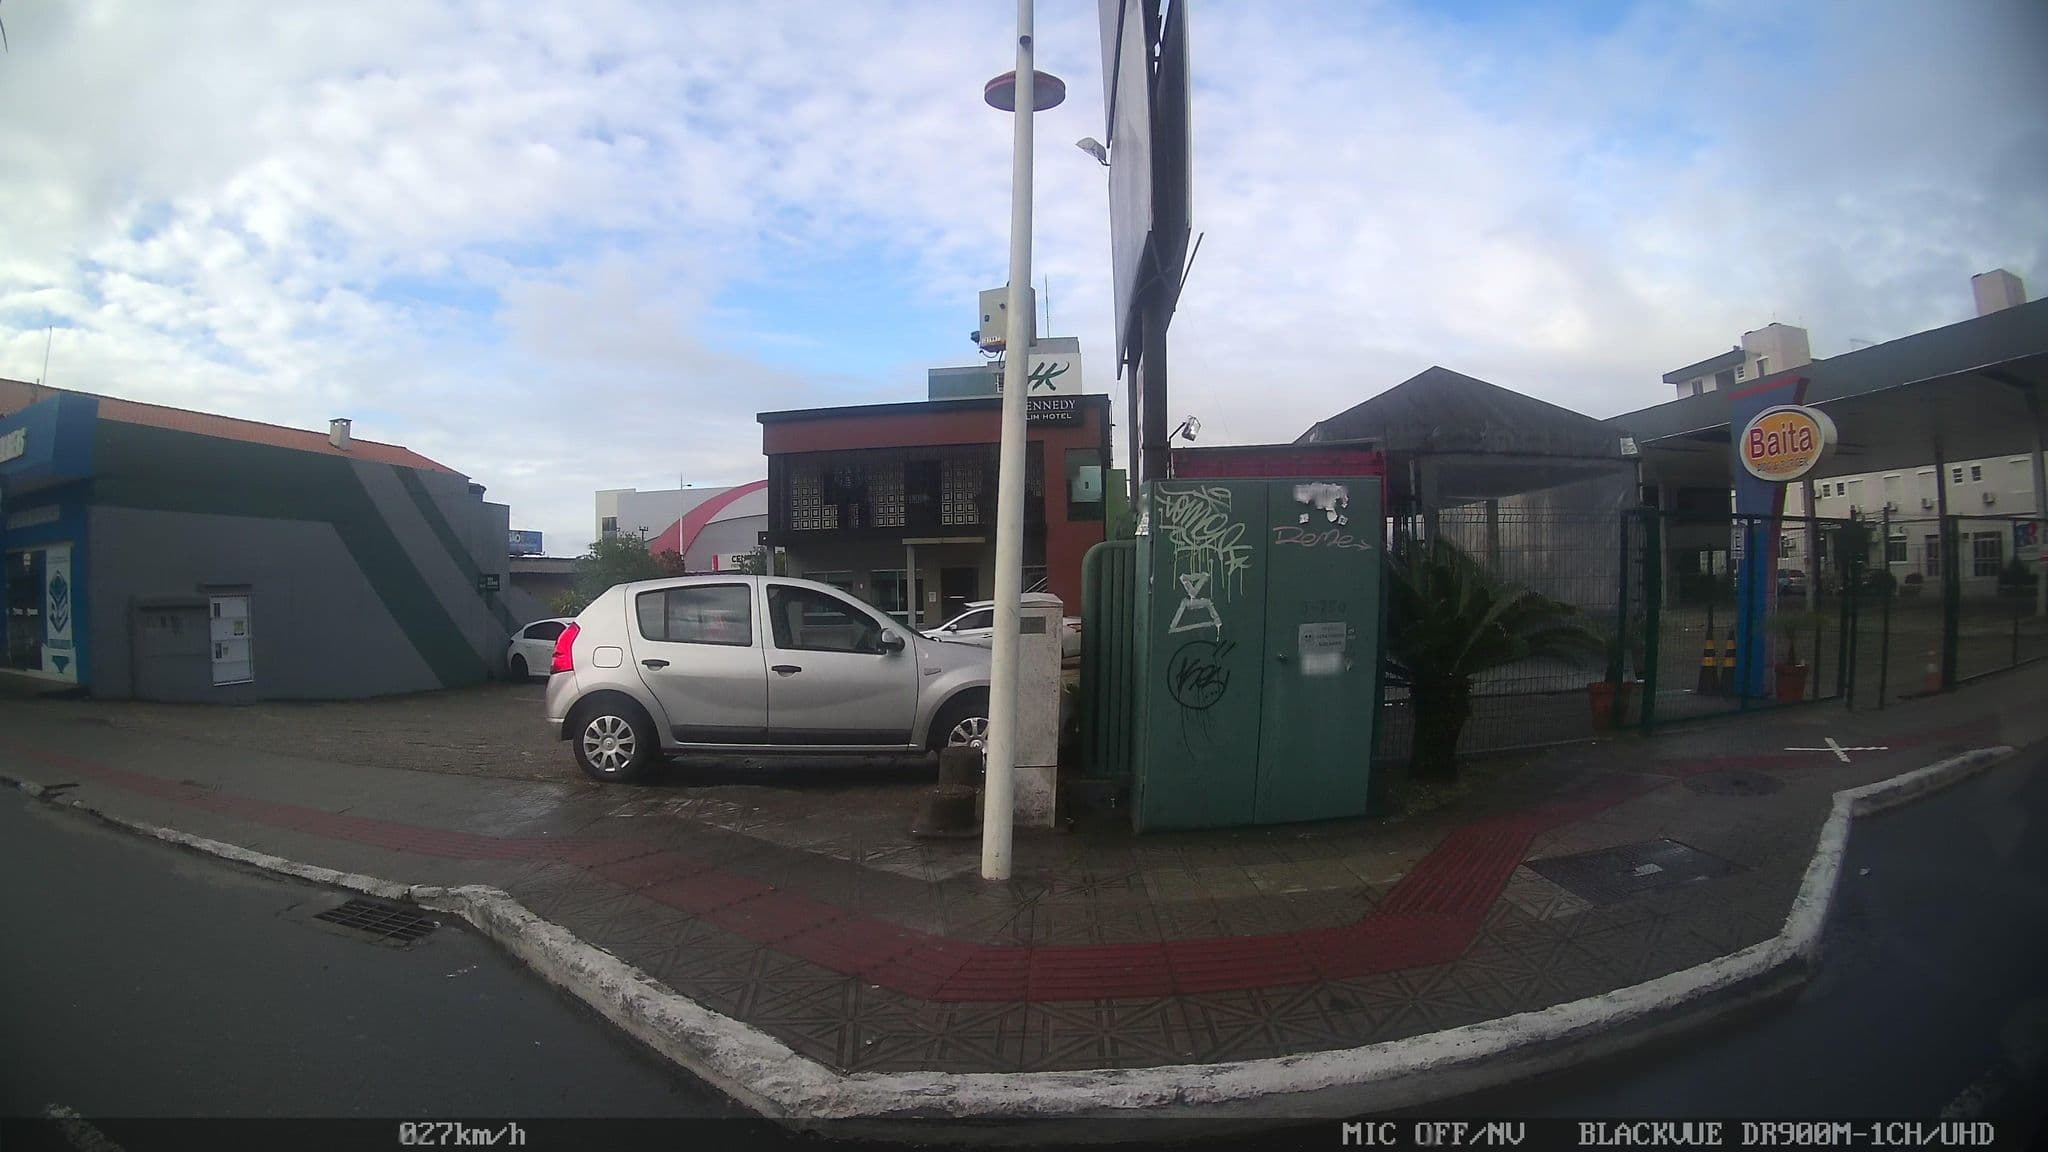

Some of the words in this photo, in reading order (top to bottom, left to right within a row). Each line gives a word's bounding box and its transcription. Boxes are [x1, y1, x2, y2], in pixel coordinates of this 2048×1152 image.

[1027, 400, 1076, 411] ENNEDY
[1042, 412, 1072, 420] HOTEL
[1749, 422, 1813, 459] Baita
